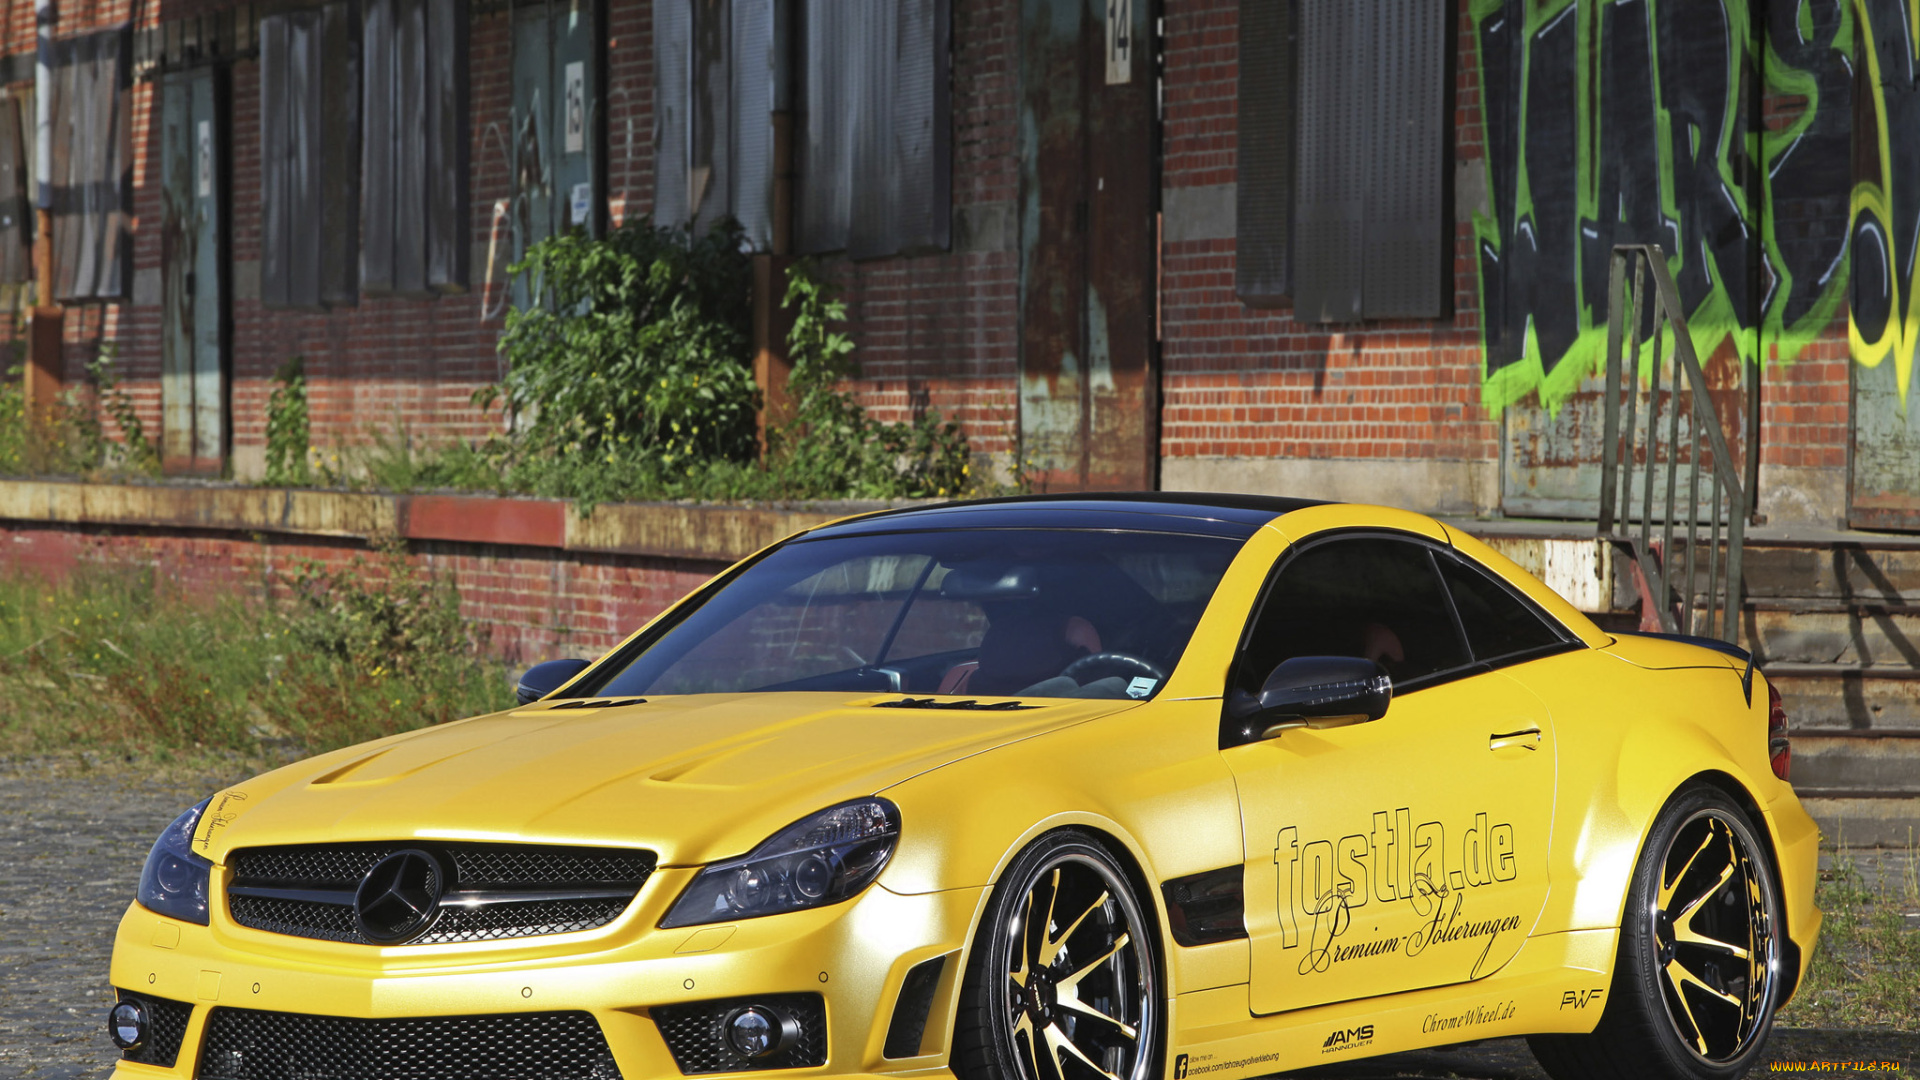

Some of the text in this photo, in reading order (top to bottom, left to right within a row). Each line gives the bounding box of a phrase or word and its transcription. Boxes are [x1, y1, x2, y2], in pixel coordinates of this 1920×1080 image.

[1109, 0, 1129, 62] 14
[567, 77, 583, 135] 15
[1274, 807, 1517, 950] fostla.de
[1422, 1000, 1516, 1034] ChromeWheel.de
[1321, 1039, 1373, 1055] HANNOVER
